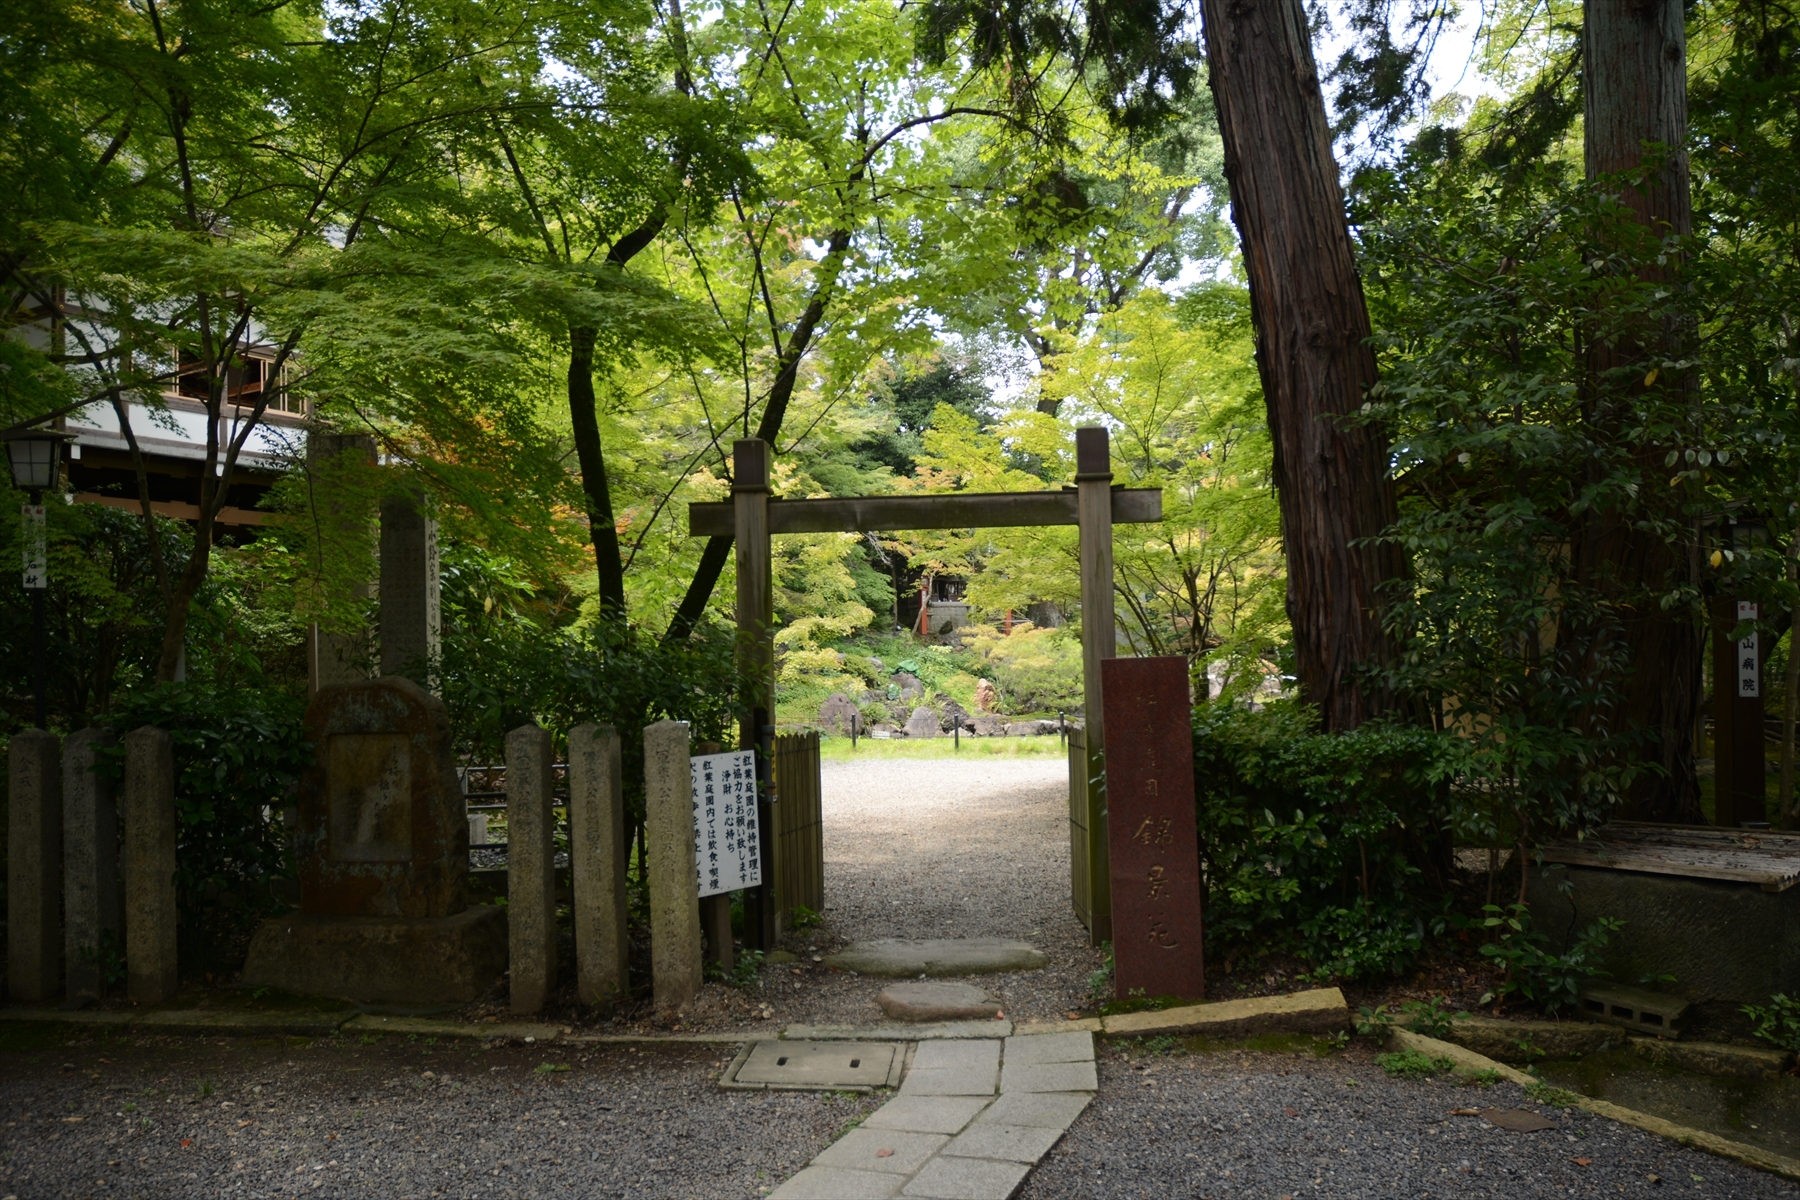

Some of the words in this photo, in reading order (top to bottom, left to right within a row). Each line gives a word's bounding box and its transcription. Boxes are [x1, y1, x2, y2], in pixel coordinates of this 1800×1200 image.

[724, 803, 736, 853] お心持ち
[733, 756, 748, 884] ご協力をお願い致します
[743, 755, 758, 882] 紅葉庭園の維持管理に
